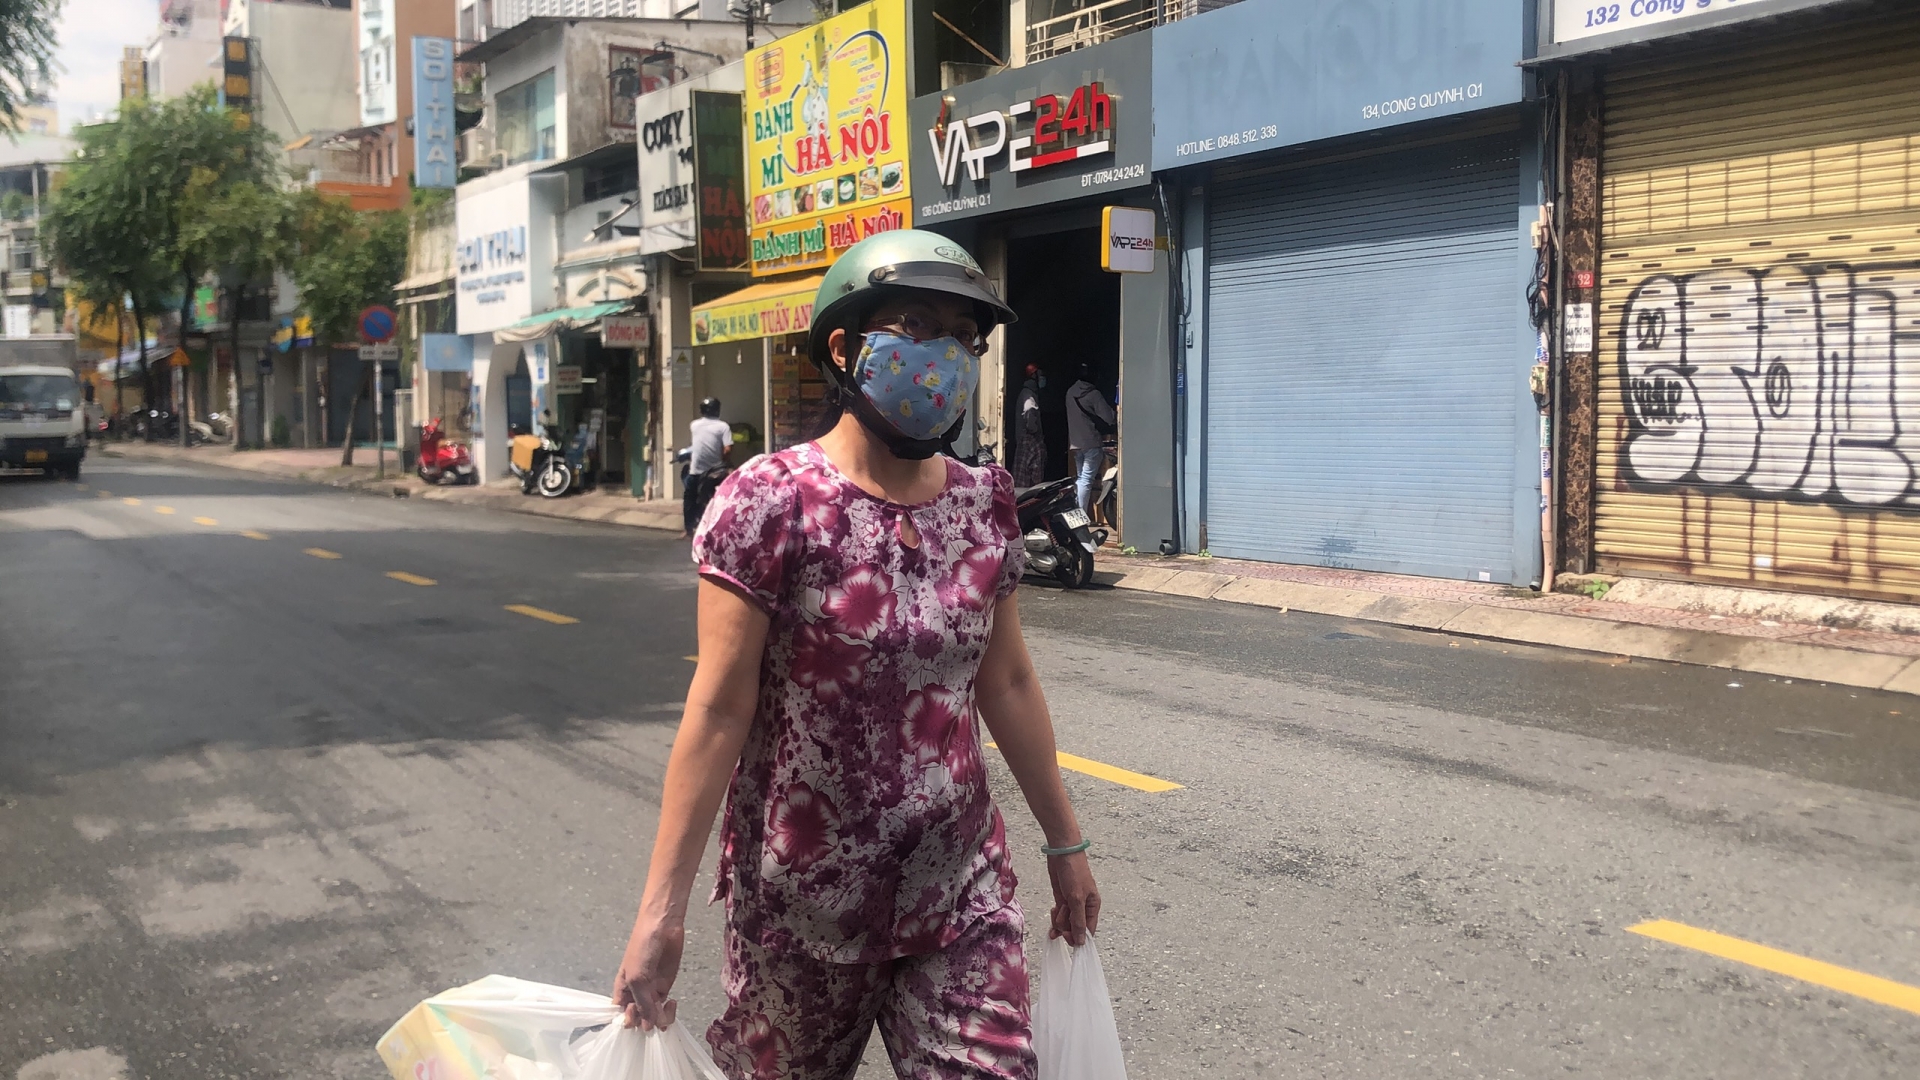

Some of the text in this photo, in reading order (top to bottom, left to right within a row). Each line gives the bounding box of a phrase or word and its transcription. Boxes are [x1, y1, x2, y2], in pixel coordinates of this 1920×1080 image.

[1585, 4, 1620, 28] 132
[1381, 96, 1416, 115] CONG
[1419, 88, 1465, 108] QUYNH,
[1467, 83, 1484, 99] Q1
[643, 109, 684, 153] COZY
[754, 99, 794, 142] BÁNH
[796, 104, 891, 175] HÀ NỘI
[1176, 137, 1216, 157] HOTLINE:
[1260, 125, 1277, 140] 338
[752, 230, 800, 262] BÁNH
[760, 302, 790, 334] TUẤN
[793, 304, 813, 330] AN
